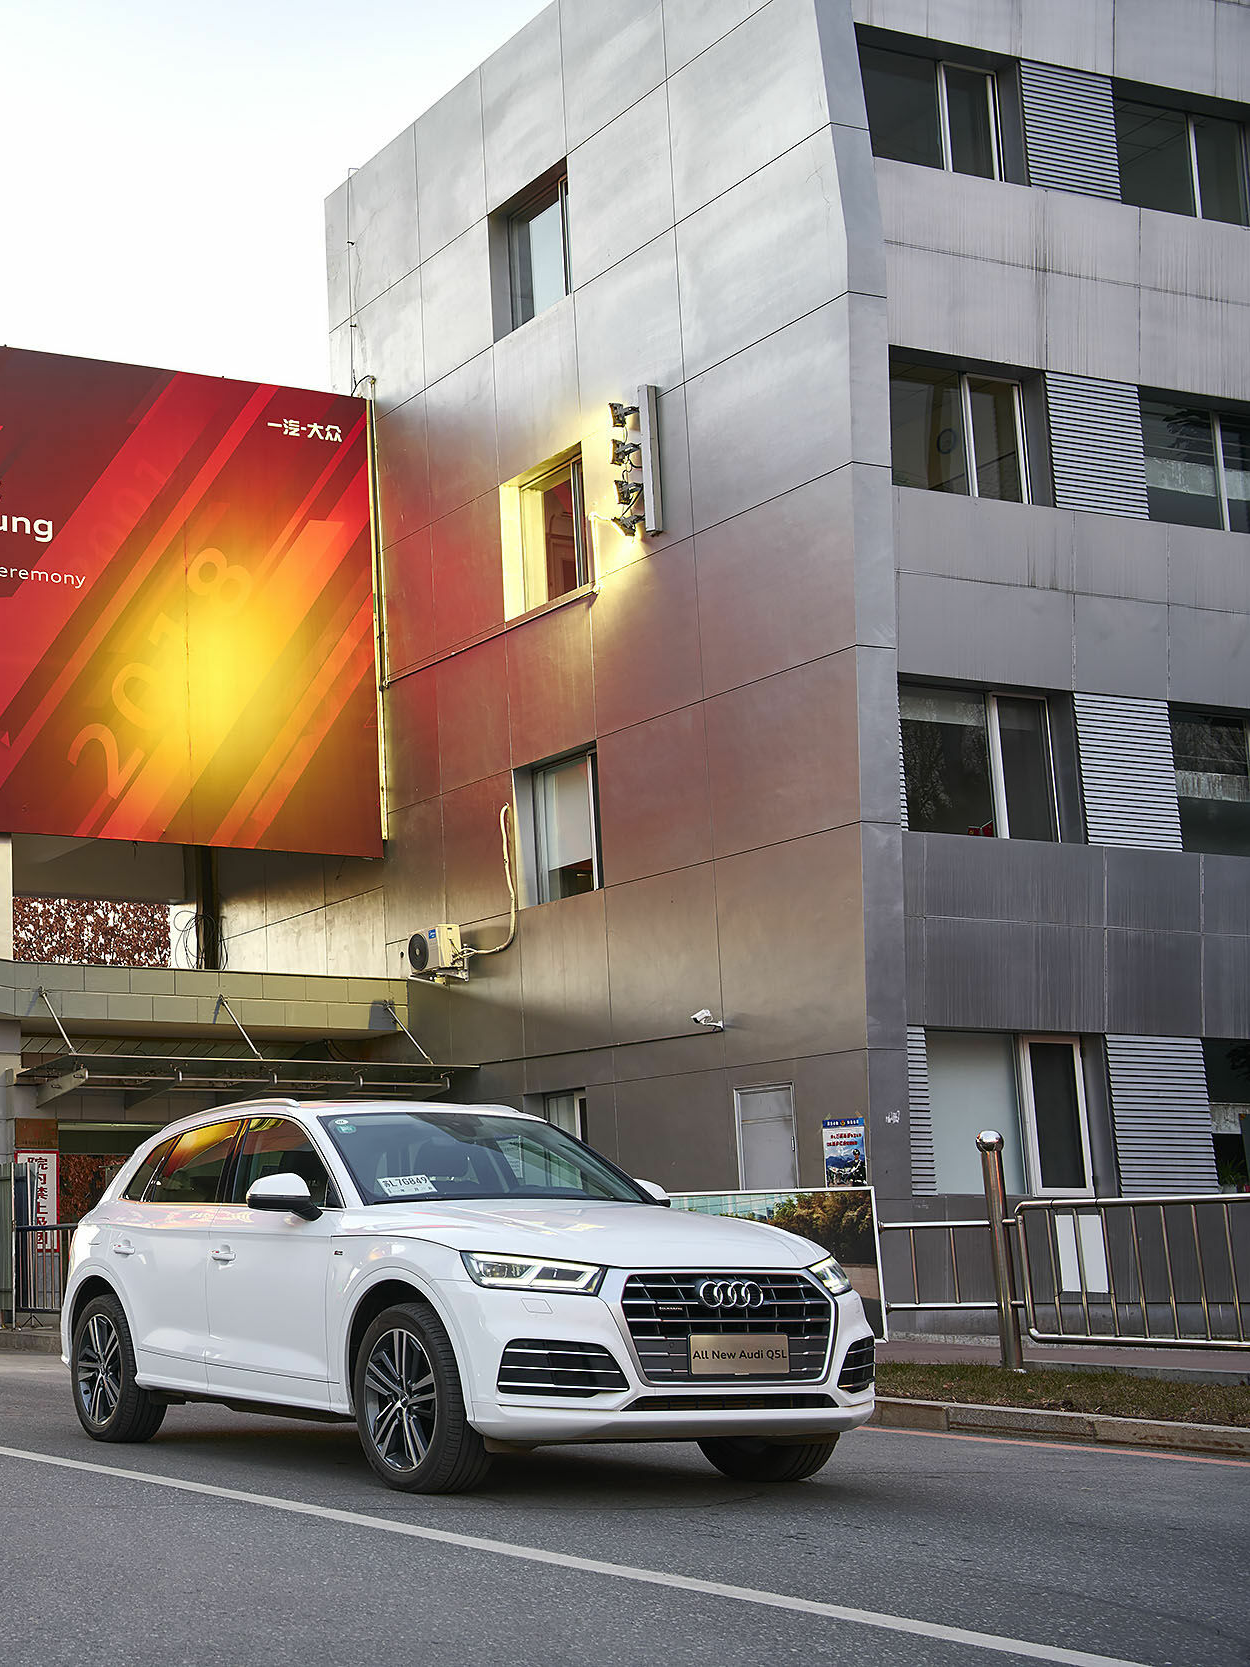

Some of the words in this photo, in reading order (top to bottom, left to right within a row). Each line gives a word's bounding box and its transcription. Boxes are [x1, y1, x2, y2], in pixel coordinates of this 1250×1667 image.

[693, 1350, 709, 1360] All
[712, 1350, 736, 1360] New
[739, 1350, 764, 1359] Audi
